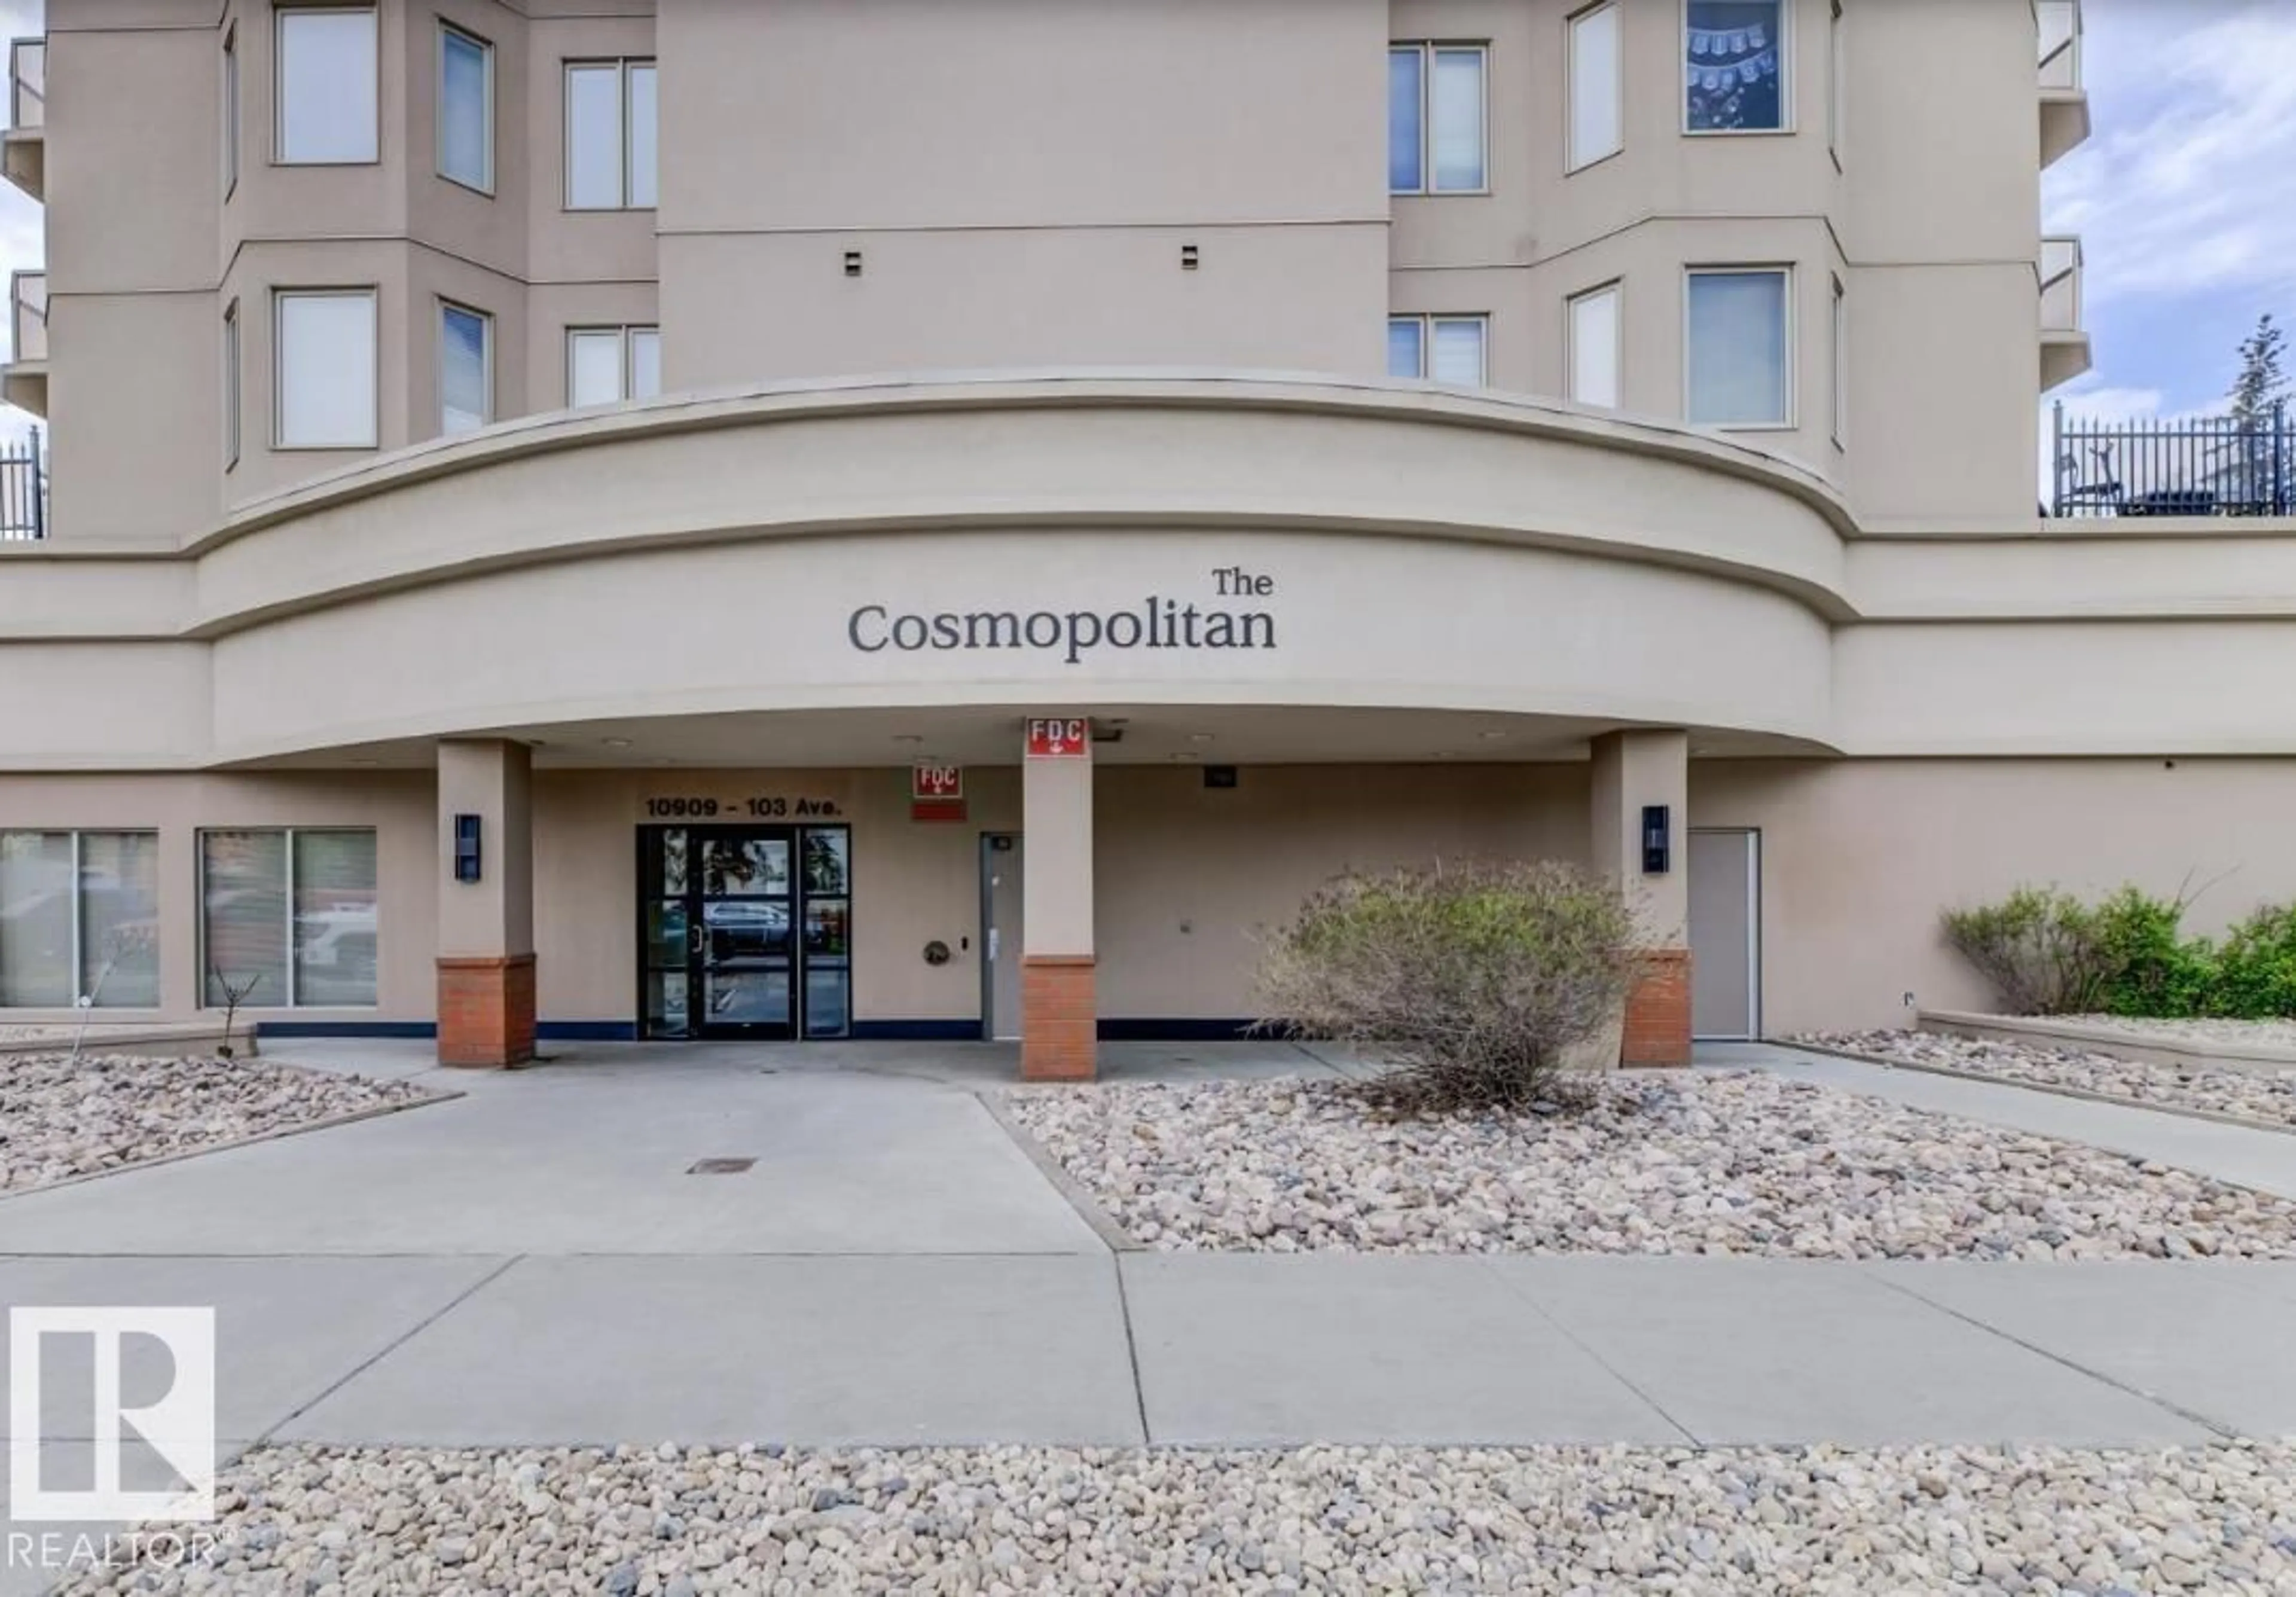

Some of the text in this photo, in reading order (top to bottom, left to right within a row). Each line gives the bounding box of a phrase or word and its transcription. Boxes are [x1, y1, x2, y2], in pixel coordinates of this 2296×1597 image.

[1211, 567, 1274, 596] The
[848, 596, 1277, 664] Cosmopolitan
[1030, 719, 1083, 742] FDC
[920, 766, 955, 786] FDC
[646, 798, 718, 817] 10909
[745, 798, 787, 817] 103
[795, 798, 842, 816] Ave.
